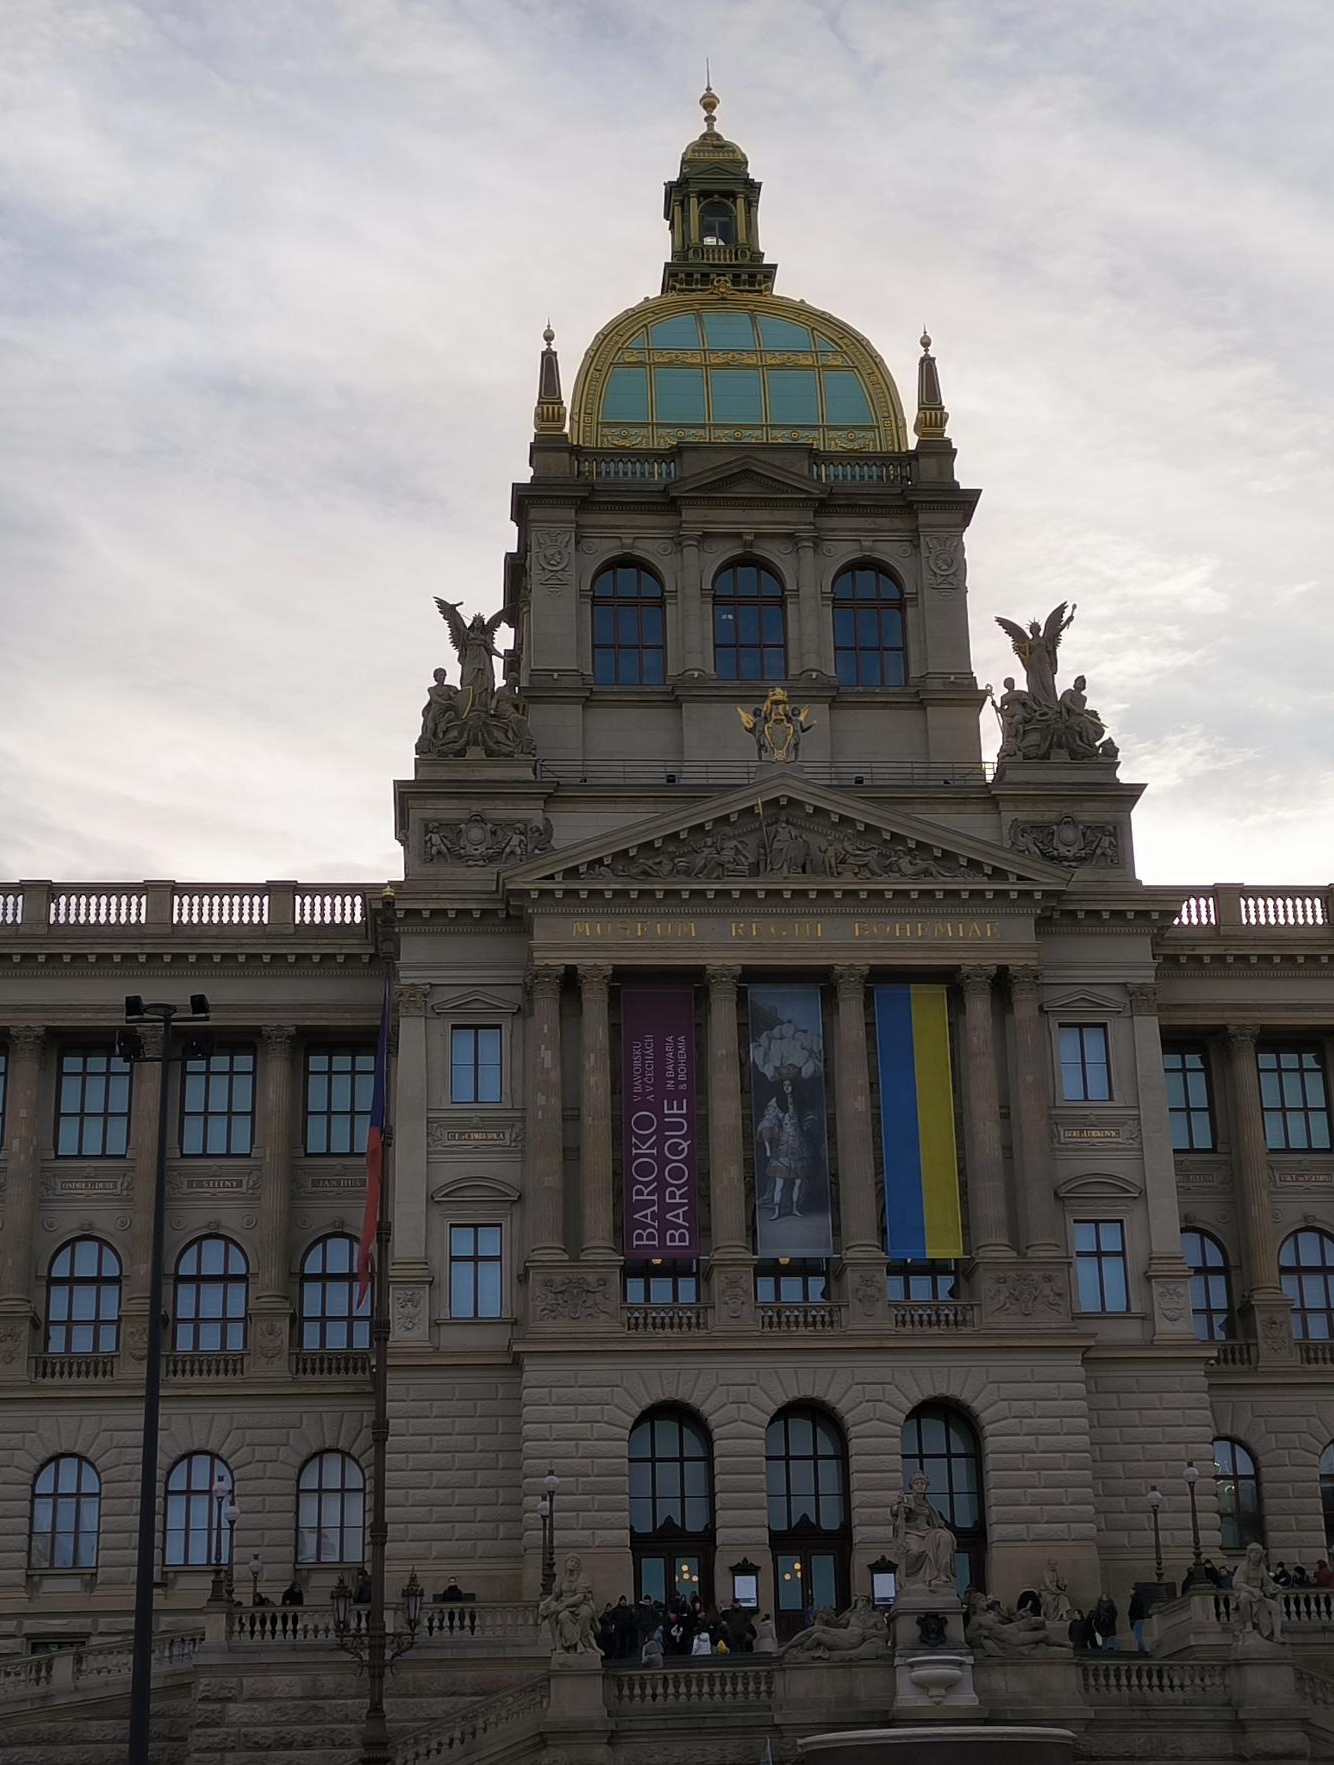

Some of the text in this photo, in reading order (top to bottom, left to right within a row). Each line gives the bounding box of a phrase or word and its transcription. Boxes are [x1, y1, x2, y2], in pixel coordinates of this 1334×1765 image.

[571, 920, 1001, 937] MUSEUM REGNI BOHEMIAE
[632, 1041, 643, 1093] BAVORSKU
[665, 1035, 676, 1090] IN BAVARIA
[677, 1035, 688, 1081] BOHEMIA
[631, 1111, 659, 1248] BAROKO
[663, 1098, 691, 1247] BAROQUE
